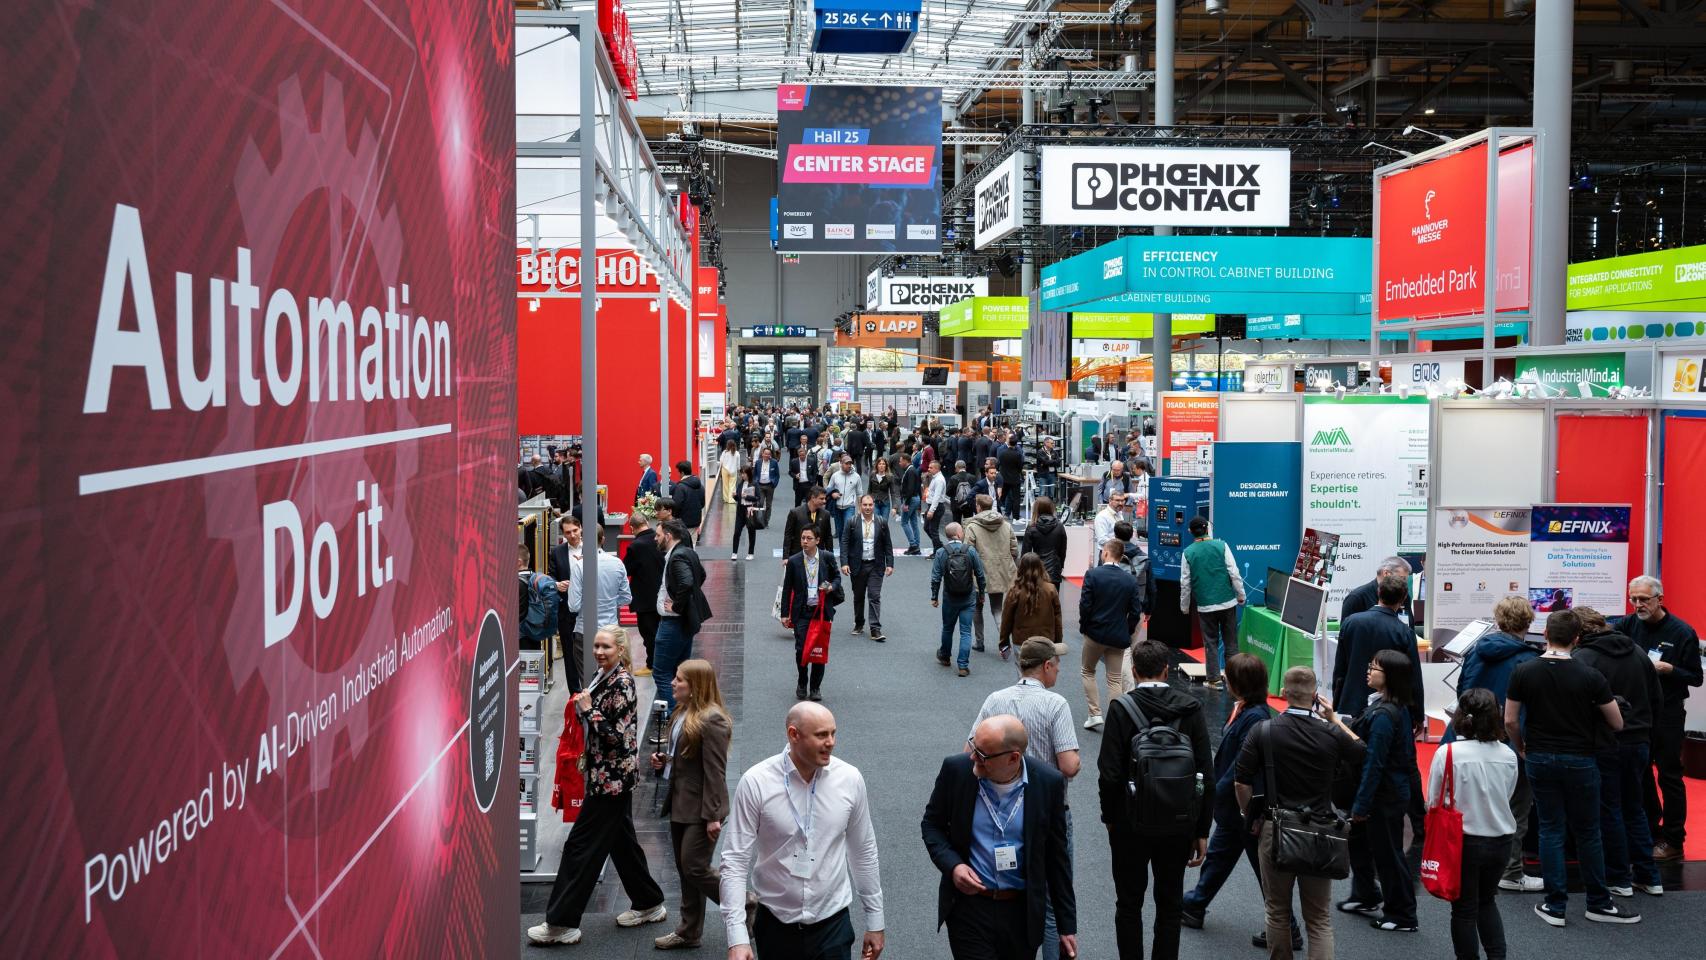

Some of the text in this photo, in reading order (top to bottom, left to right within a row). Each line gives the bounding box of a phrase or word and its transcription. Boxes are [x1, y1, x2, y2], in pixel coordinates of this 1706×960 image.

[825, 13, 857, 24] 25 26
[814, 131, 859, 143] Hall 25
[793, 156, 925, 173] CENTER STAGE
[1119, 188, 1261, 212] CONTACT
[985, 194, 1010, 230] CONTACT
[1411, 219, 1448, 236] HANNOVER
[1417, 231, 1441, 244] MESSE
[1143, 251, 1218, 262] EFFICIENCY
[521, 255, 661, 286] BECHOF
[1143, 267, 1334, 280] IN CONTROL CABINET BUILDING
[1570, 264, 1664, 285] INTEGRATED CONNECTIVITY
[1385, 265, 1477, 302] Embedded Park
[1570, 280, 1653, 298] FOR SMART APPLICATIONS
[1121, 294, 1162, 302] CABINET
[1165, 294, 1211, 303] BUILDING
[83, 203, 451, 414] Automation
[879, 320, 918, 333] LAPP
[1111, 343, 1130, 352] LAPP
[1413, 363, 1440, 382] GMK
[1542, 368, 1620, 384] IndustrialMind.ai
[1202, 450, 1208, 459] F
[1310, 471, 1387, 481] Experience retires.
[1419, 469, 1425, 480] F
[1310, 483, 1358, 495] Expertise
[1310, 499, 1361, 509] shouldn't.
[263, 480, 394, 649] Do it.
[84, 606, 453, 924] Powered by AI-Driven Industrial Automation.
